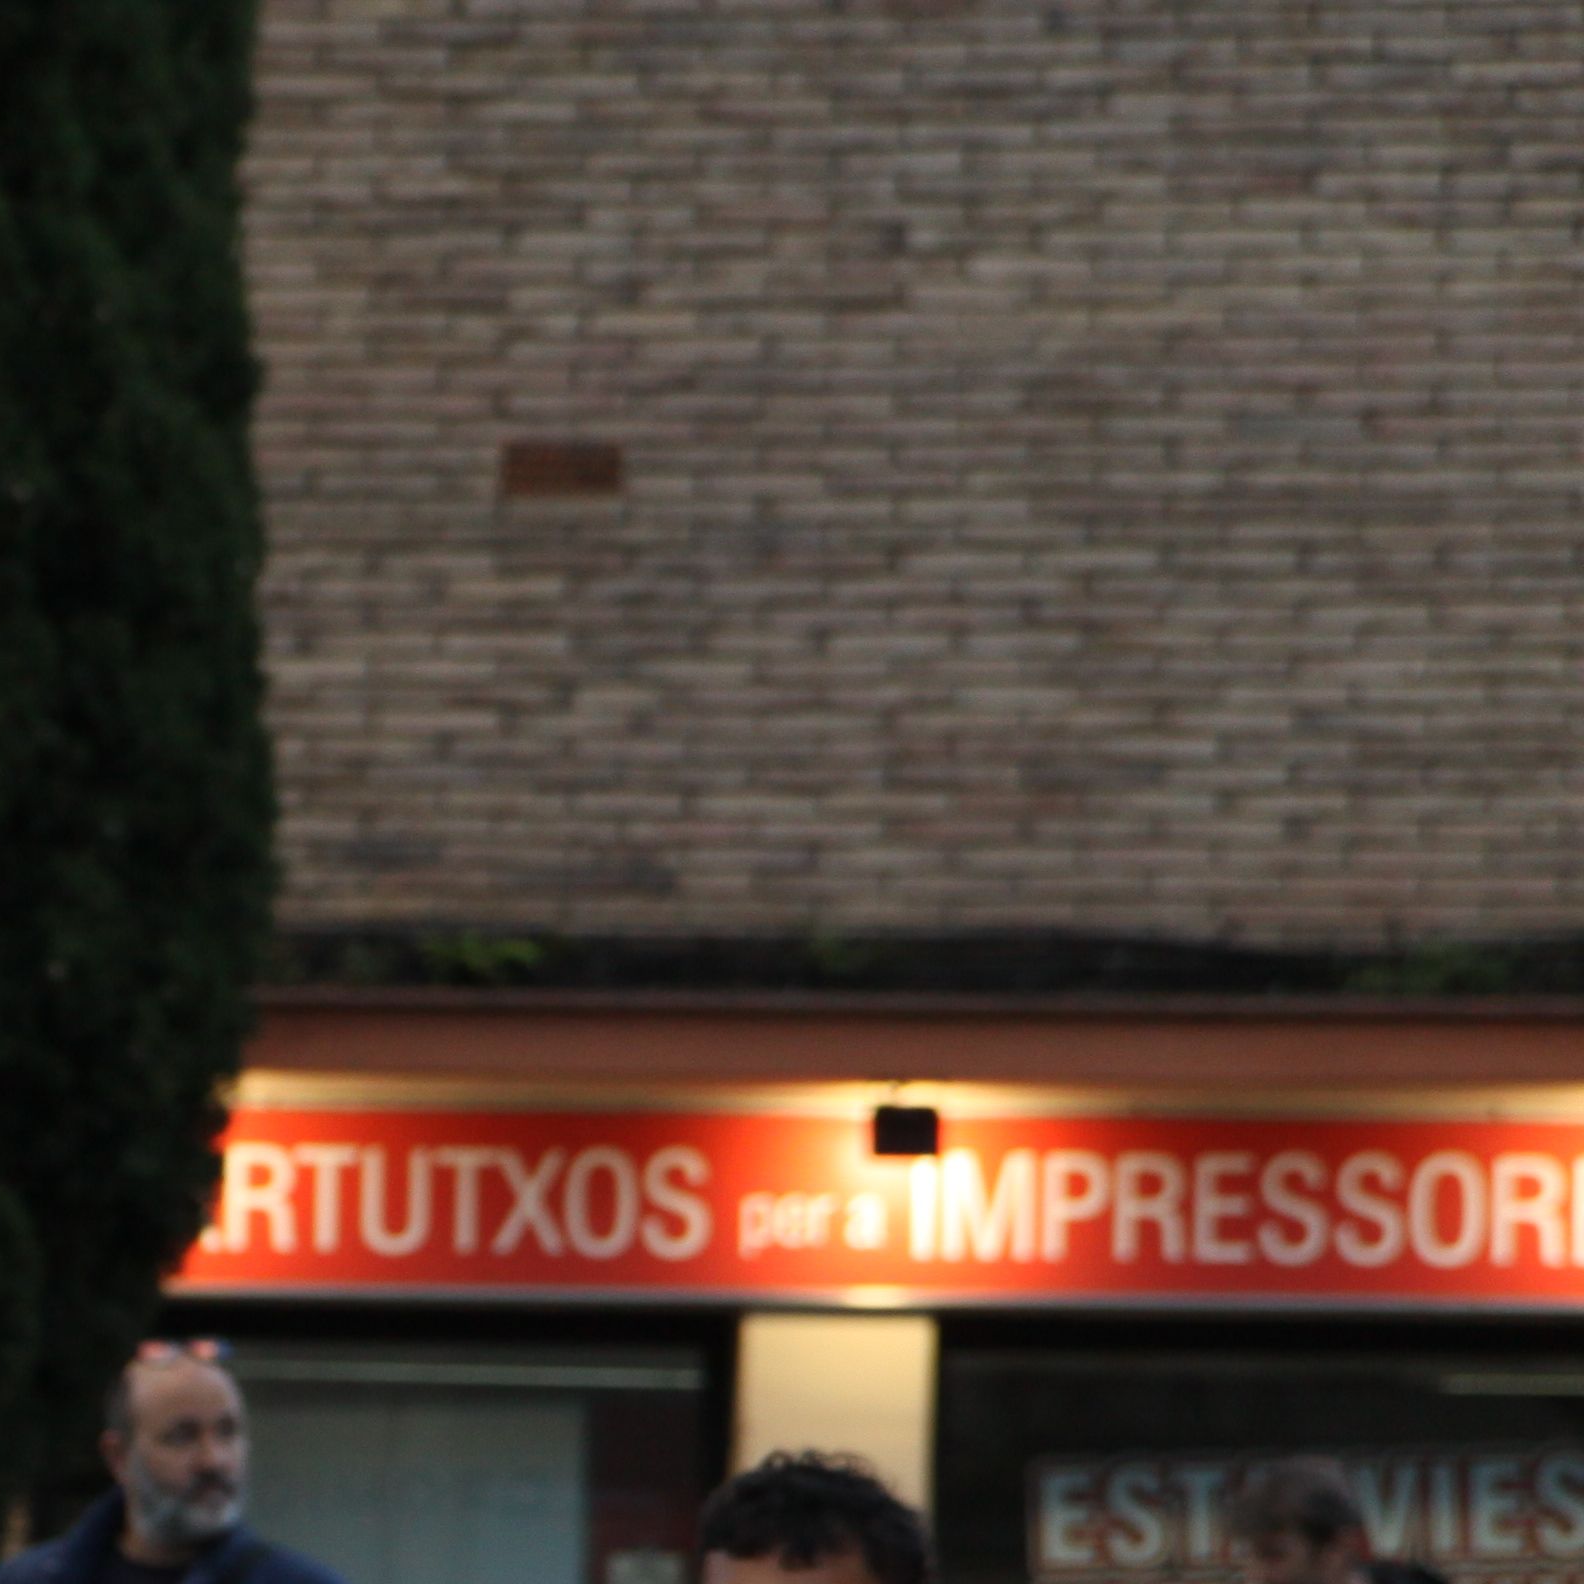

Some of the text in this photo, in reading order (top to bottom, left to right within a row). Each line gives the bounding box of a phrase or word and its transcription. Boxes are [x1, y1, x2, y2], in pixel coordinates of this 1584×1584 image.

[198, 1140, 713, 1261] RTUTXOS
[737, 1189, 838, 1262] per
[844, 1191, 888, 1251] a
